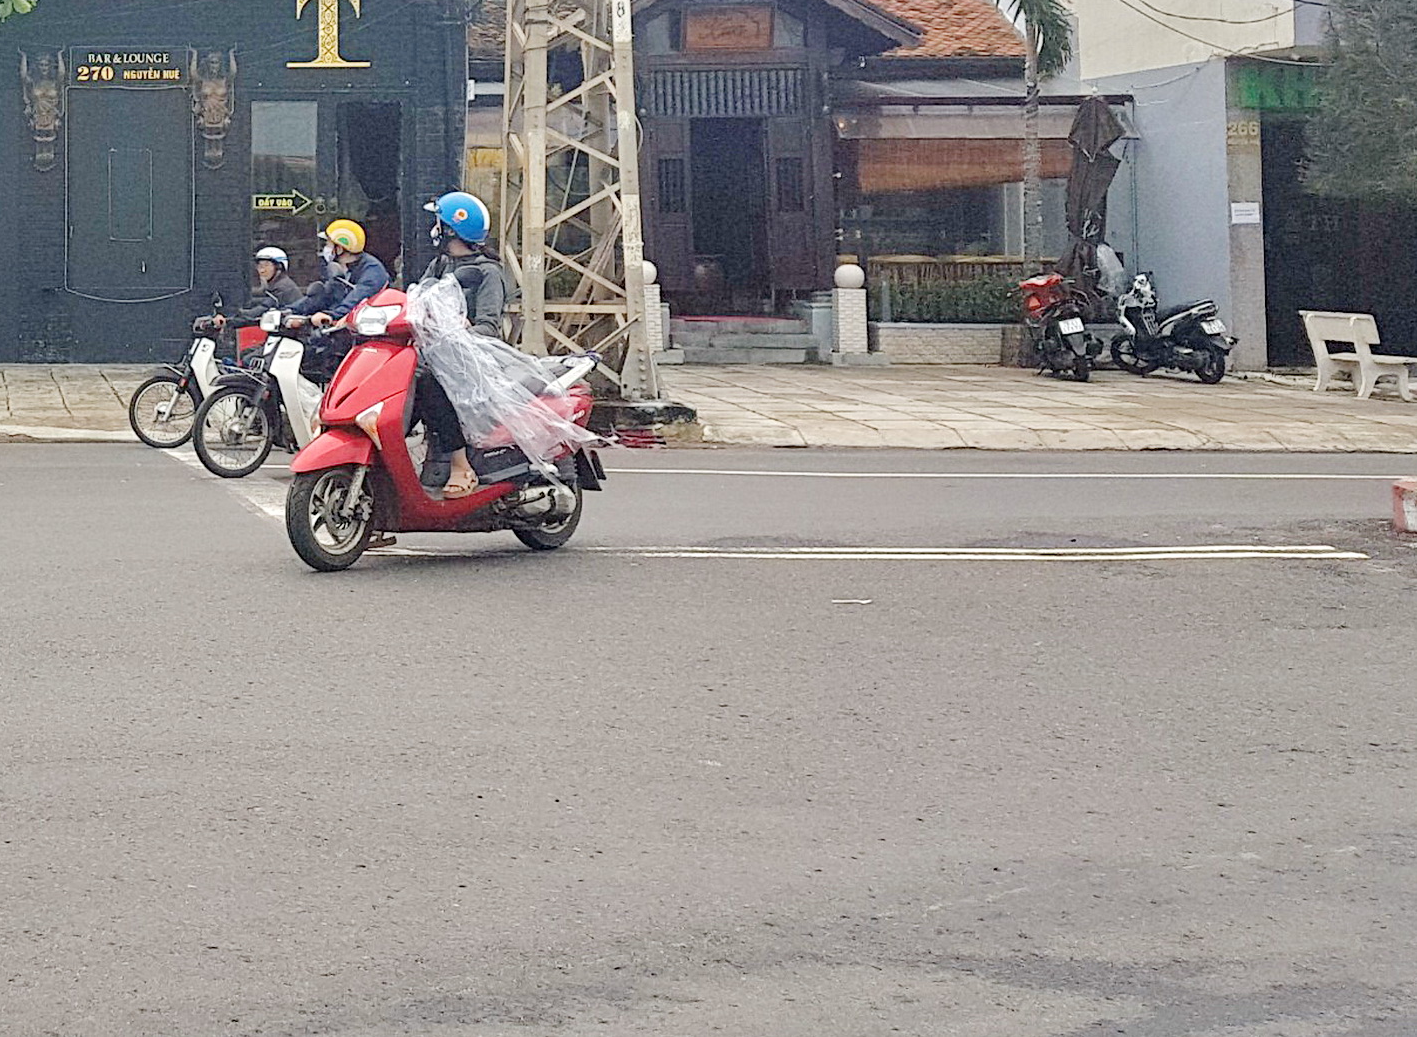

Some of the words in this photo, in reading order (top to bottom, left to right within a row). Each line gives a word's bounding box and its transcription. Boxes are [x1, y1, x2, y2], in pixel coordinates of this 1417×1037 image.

[88, 53, 112, 63] BAR
[123, 53, 169, 63] LOUNGE
[77, 65, 114, 81] 270
[1227, 121, 1259, 136] 266
